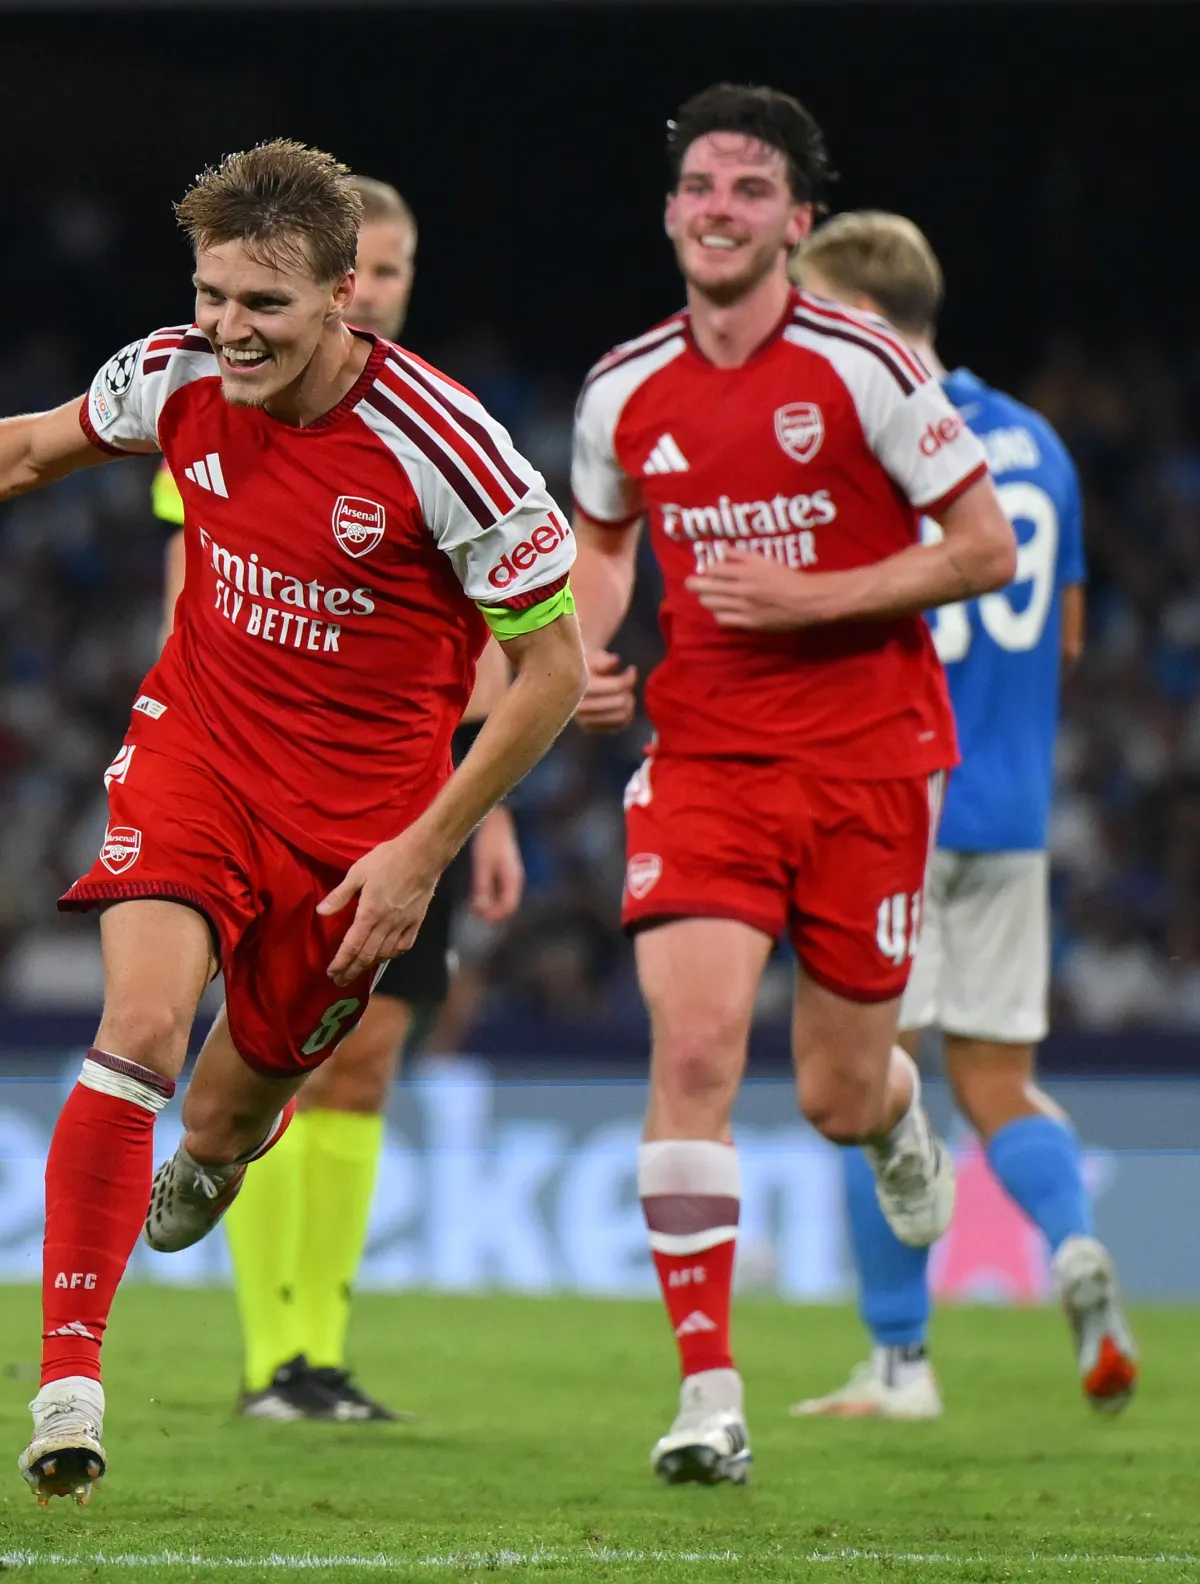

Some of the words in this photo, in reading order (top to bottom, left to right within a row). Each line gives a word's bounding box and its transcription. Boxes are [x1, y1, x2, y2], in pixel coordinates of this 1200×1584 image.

[918, 416, 962, 457] de
[341, 505, 378, 522] Arsenal
[214, 579, 244, 625] FLY
[246, 603, 341, 652] BETTER
[301, 997, 360, 1055] 8
[54, 1271, 98, 1290] AFC
